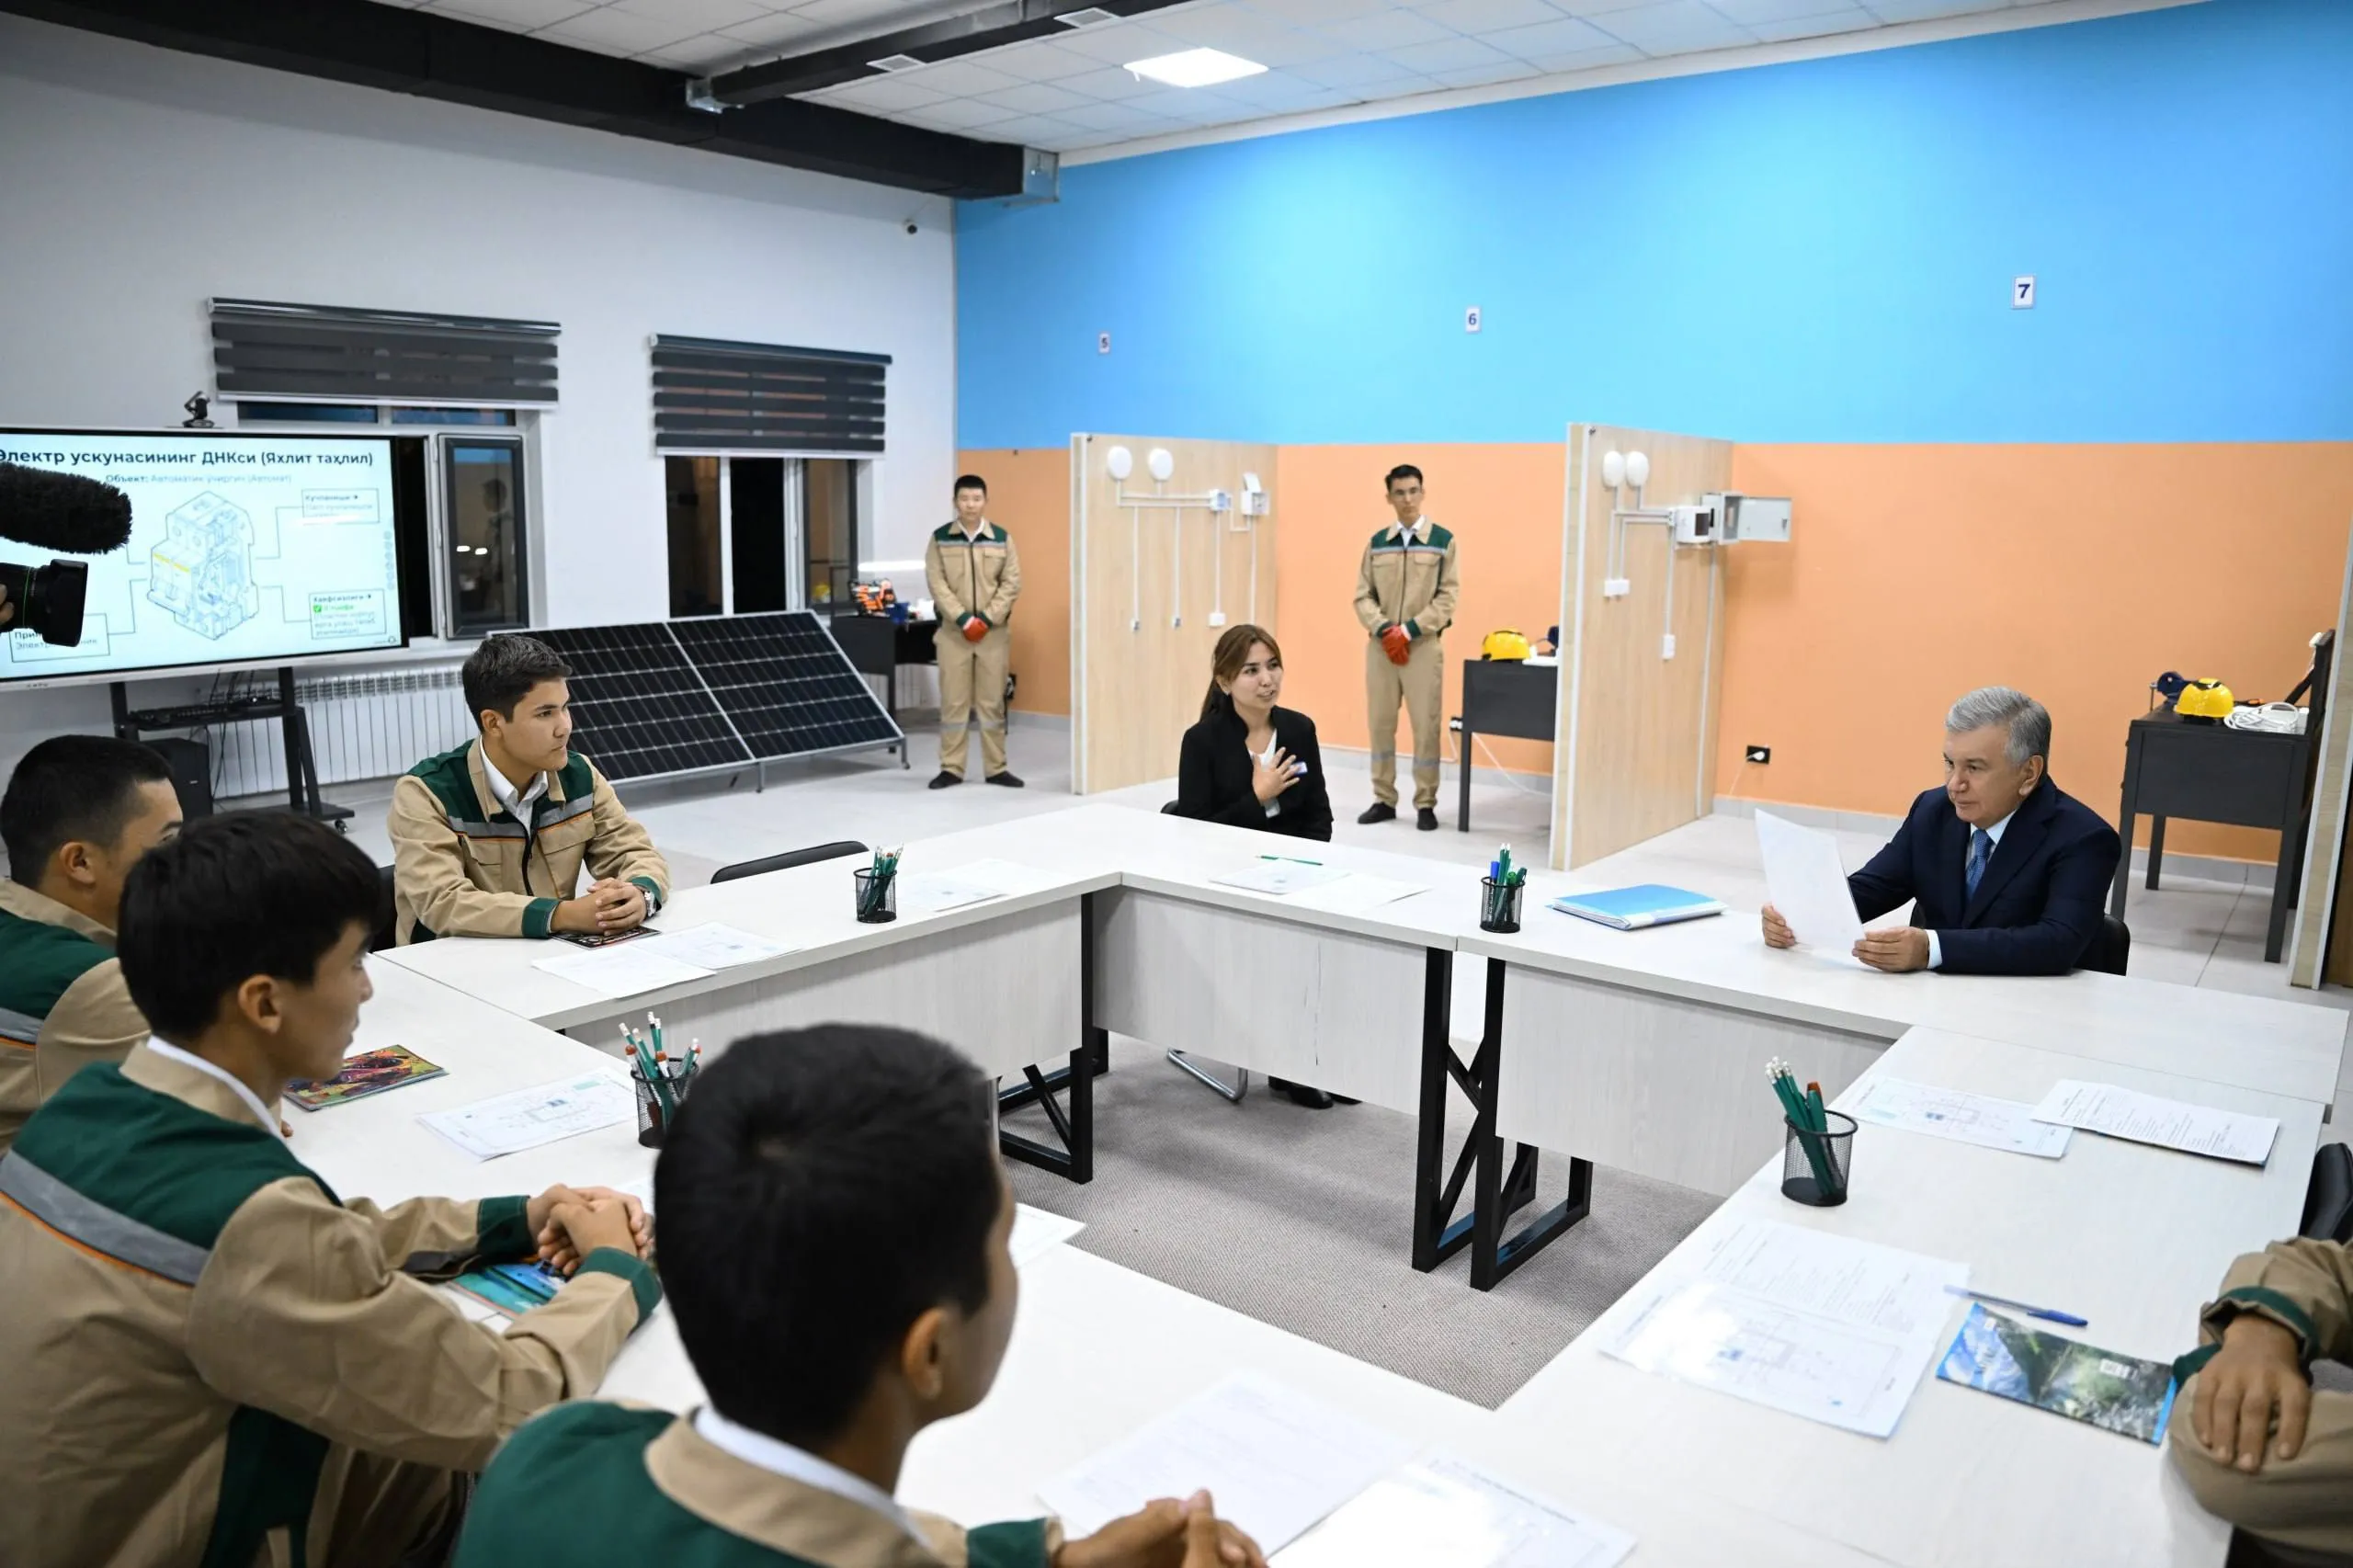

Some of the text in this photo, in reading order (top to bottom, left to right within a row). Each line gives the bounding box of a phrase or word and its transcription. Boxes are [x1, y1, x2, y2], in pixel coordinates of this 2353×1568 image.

[2018, 283, 2030, 299] 7
[1469, 312, 1477, 325] 6
[0, 449, 65, 465] Электр
[71, 452, 197, 466] ускунасининг
[202, 451, 256, 465] ДНКси
[261, 451, 313, 466] (Яхлит
